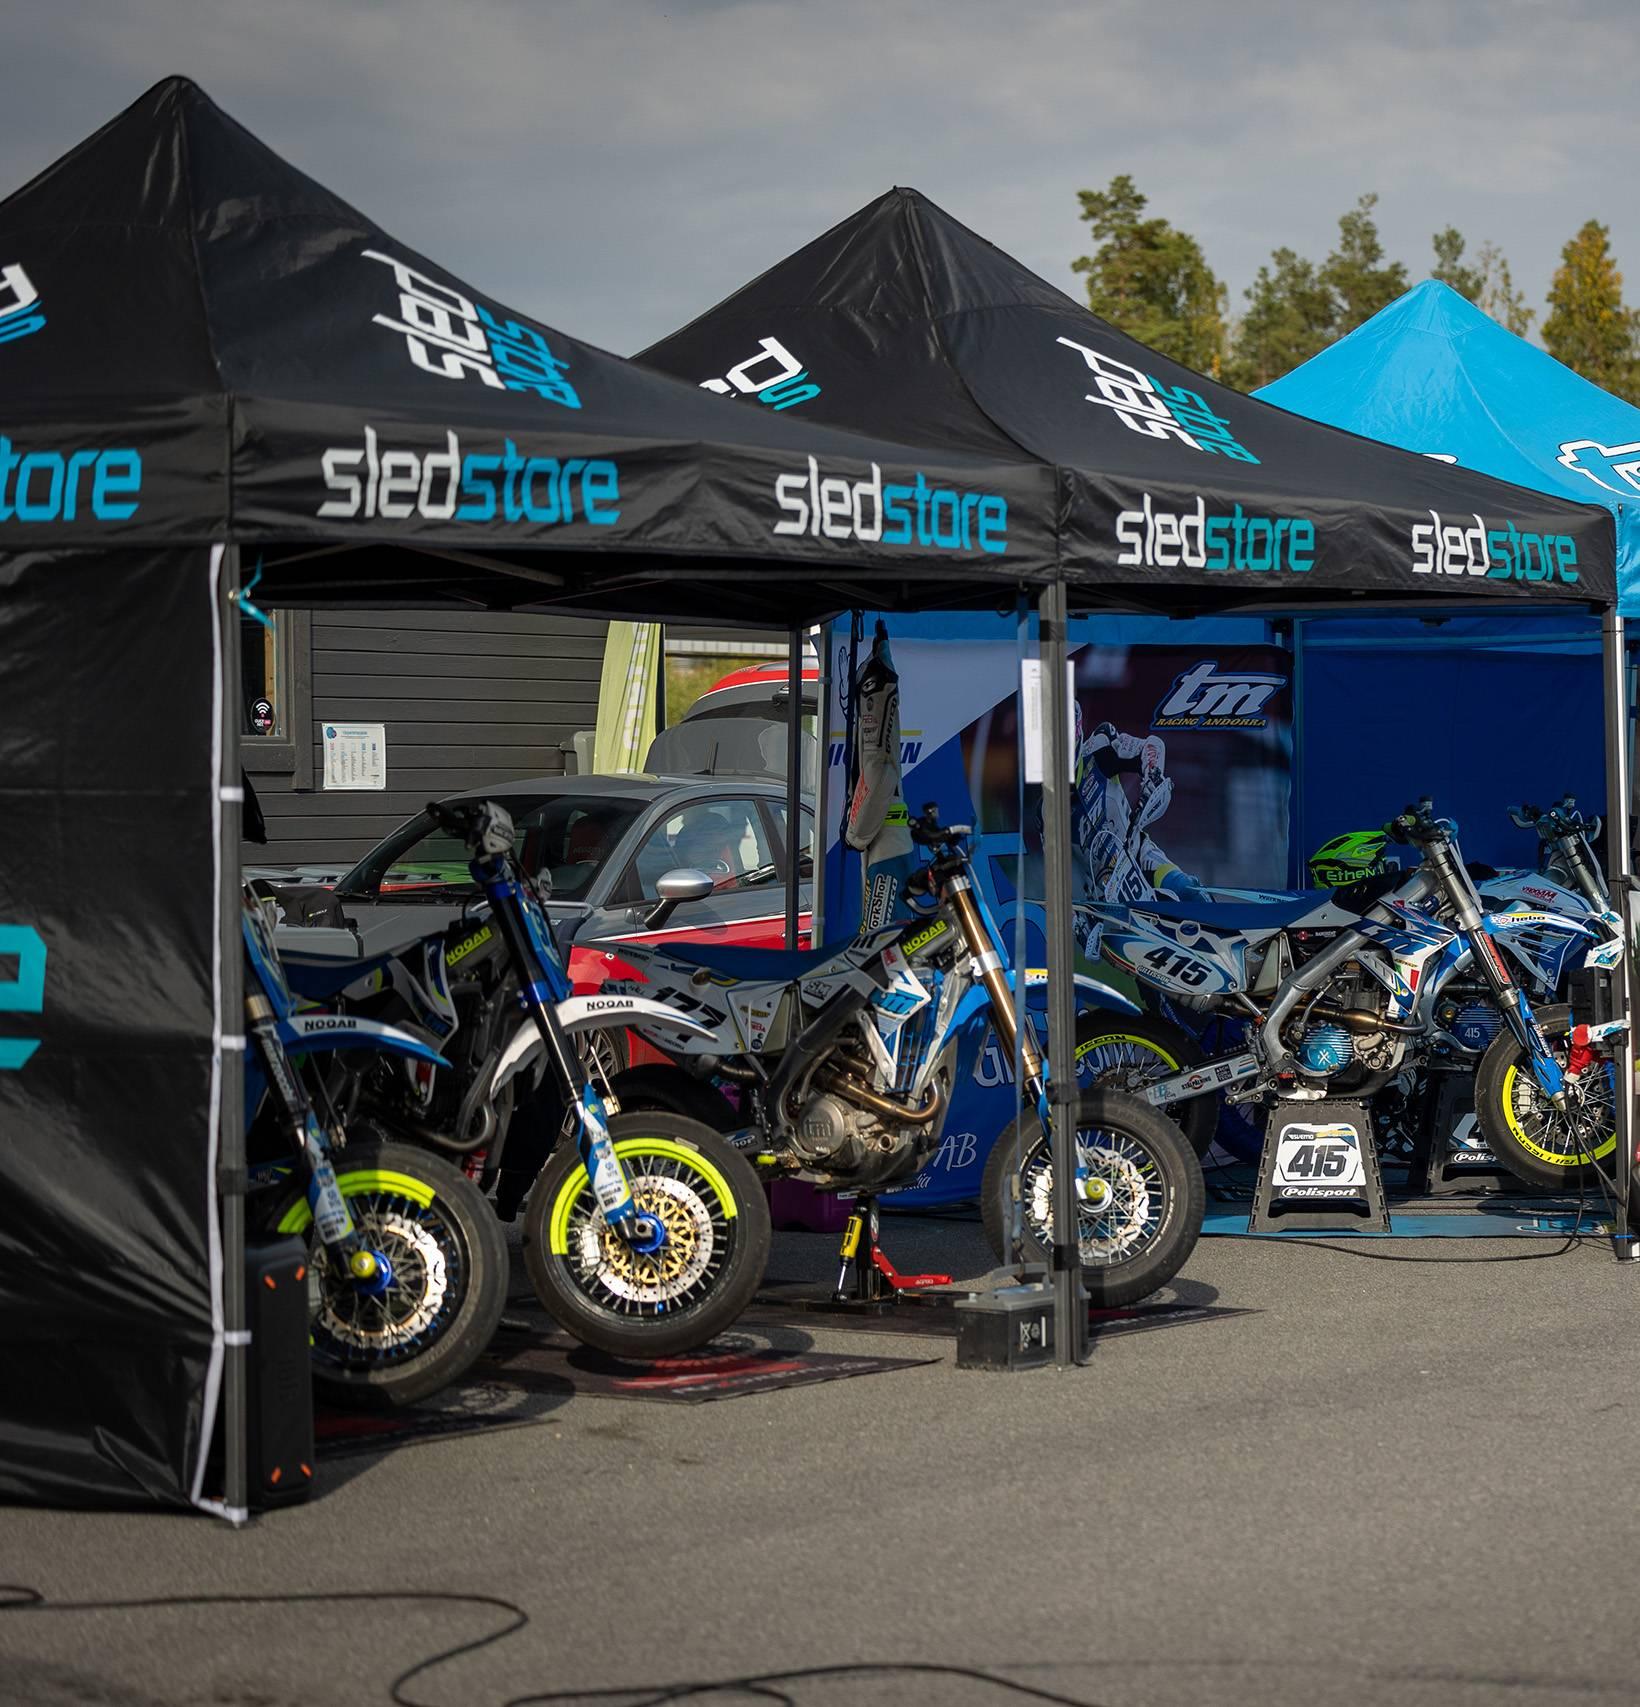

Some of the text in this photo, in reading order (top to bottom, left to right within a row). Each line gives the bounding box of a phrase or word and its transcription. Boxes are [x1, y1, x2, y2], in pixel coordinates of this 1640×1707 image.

[316, 425, 620, 525] sledstore
[773, 455, 1008, 554] sledstore
[1115, 493, 1315, 572] sledstore
[1411, 509, 1579, 583] sledstore
[1162, 664, 1286, 716] tm
[1156, 717, 1267, 727] RACING ANDORRA
[903, 920, 946, 954] NOQAB
[1511, 915, 1545, 923] hebo
[446, 926, 492, 965] NOQAB
[1143, 946, 1212, 986] 415
[586, 1000, 633, 1012] NOQAB
[304, 1019, 357, 1033] NOQAB
[1464, 1027, 1480, 1038] 415
[932, 1132, 978, 1172] AB
[1287, 1145, 1350, 1177] 415
[1283, 1187, 1357, 1198] Polisport
